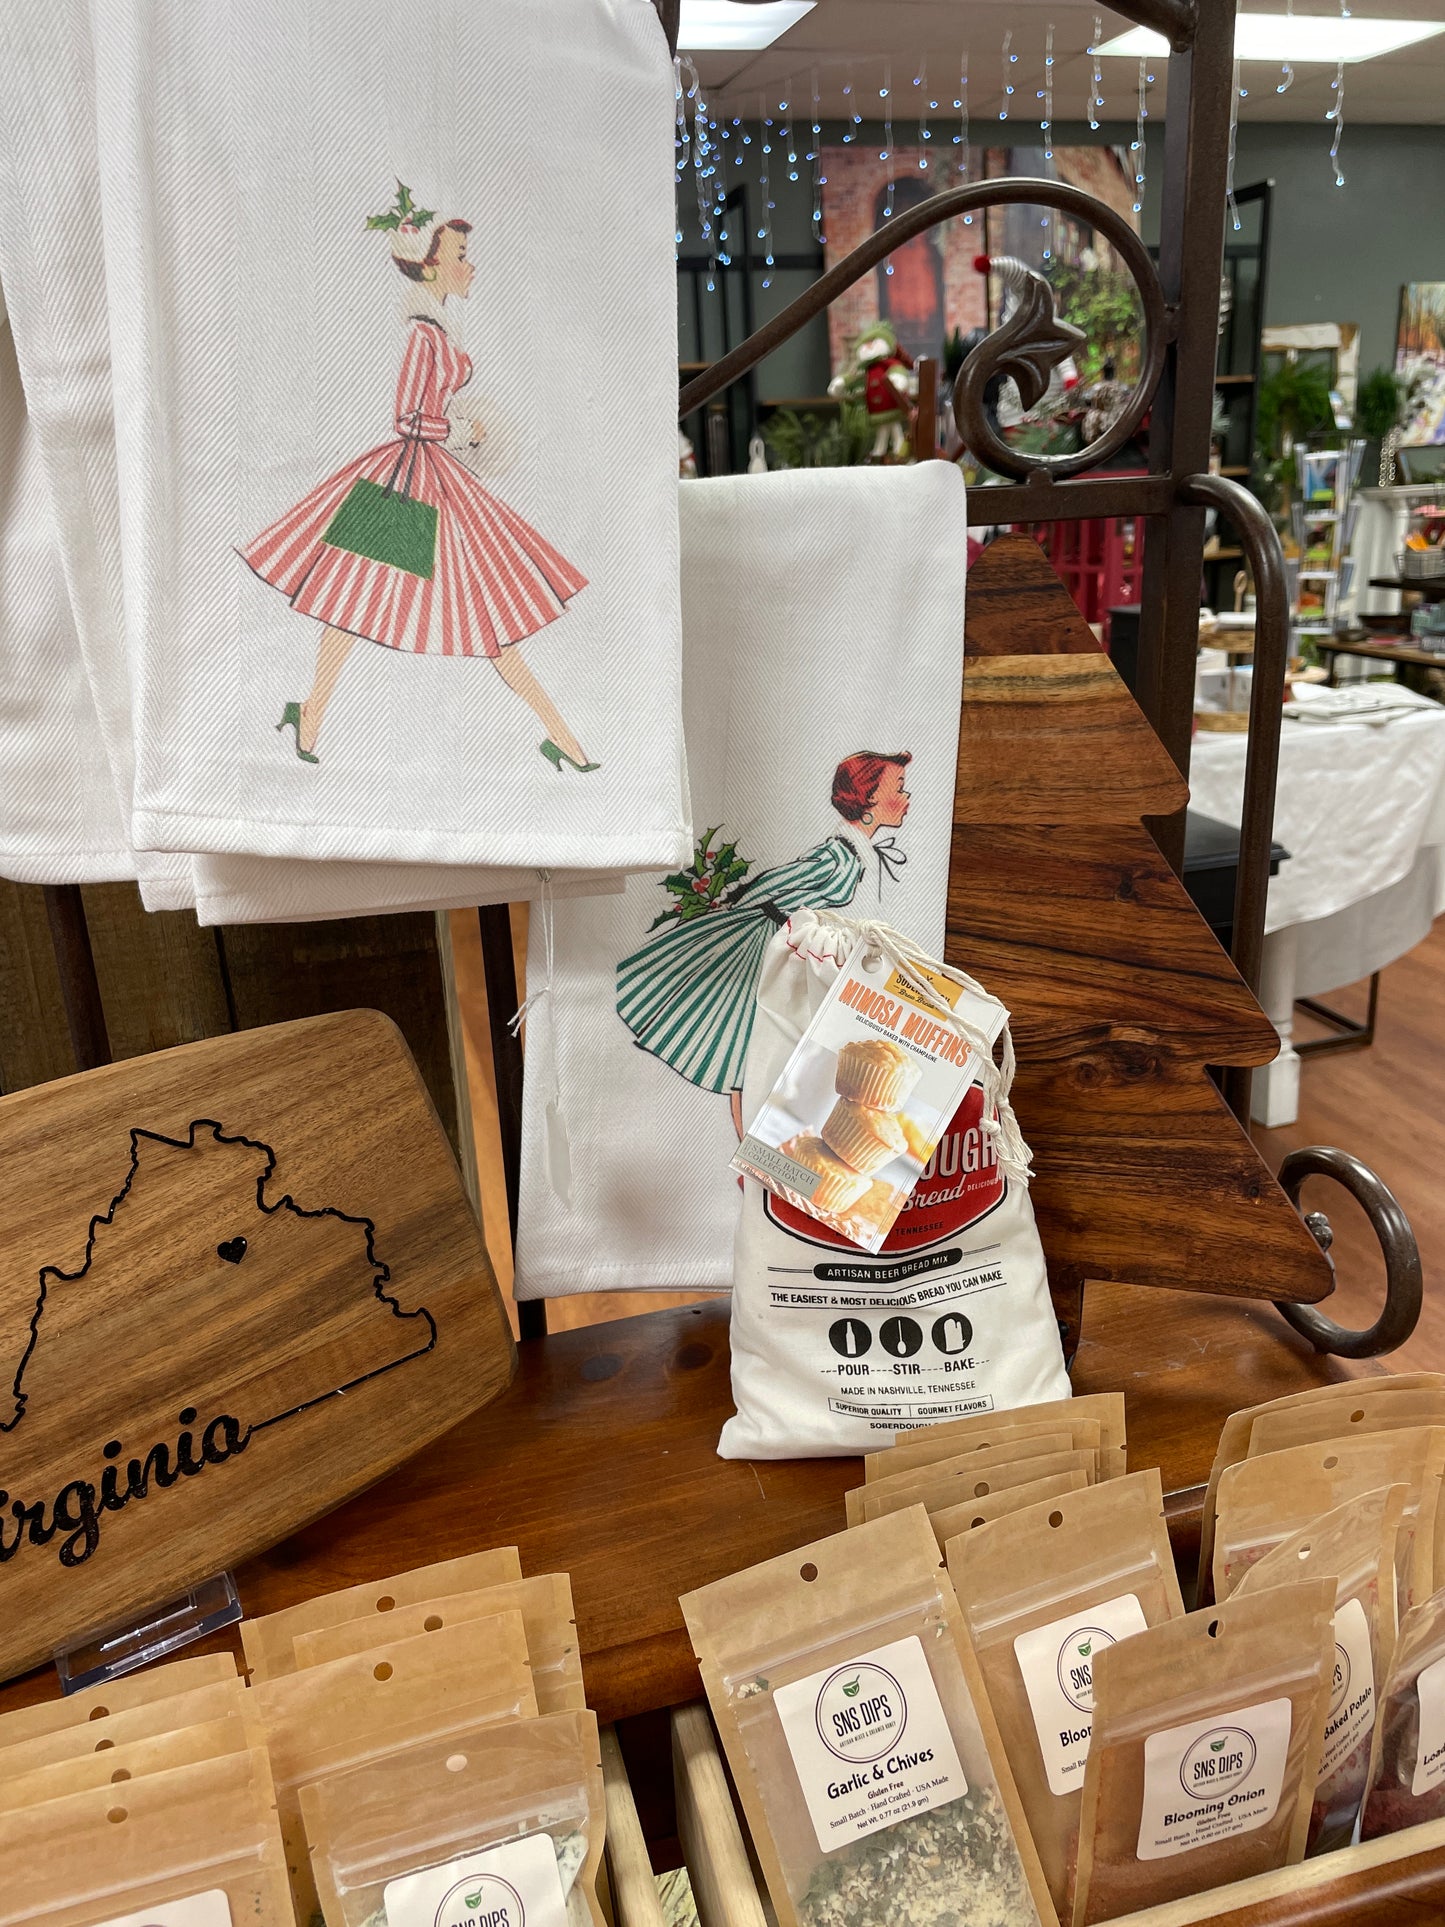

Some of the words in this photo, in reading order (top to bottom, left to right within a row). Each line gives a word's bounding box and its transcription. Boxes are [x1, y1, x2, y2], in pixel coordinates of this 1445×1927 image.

[839, 978, 903, 1031] MIMOSA
[900, 1012, 972, 1068] MUFFINS
[855, 1015, 884, 1033] DELICIOUSLY
[883, 1029, 898, 1042] BAKED
[898, 1038, 910, 1048] WITH
[909, 1044, 938, 1063] CHAMPAGNE
[748, 1151, 798, 1184] COLLECTION
[751, 1144, 781, 1166] SMALL
[783, 1160, 814, 1185] BATCH
[896, 1220, 944, 1236] TENNESSEE
[826, 1268, 872, 1279] ARTISAN
[874, 1268, 900, 1279] BEER
[902, 1260, 930, 1275] BREAD
[932, 1254, 949, 1266] MIX
[771, 1292, 789, 1303] THE
[790, 1293, 828, 1305] EASIEST
[830, 1295, 838, 1305] &
[840, 1296, 866, 1306] MOST
[869, 1293, 916, 1306] DELICIOUS
[918, 1286, 946, 1302] BREAD
[944, 1280, 962, 1294] YOU
[963, 1276, 980, 1289] CAN
[980, 1270, 1003, 1286] MAKE
[838, 1364, 870, 1376] POUR
[892, 1364, 921, 1376] STIR
[944, 1358, 976, 1373] BAKE
[841, 1386, 865, 1396] MADE
[868, 1386, 876, 1395] IN
[878, 1386, 926, 1396] NASHVILLE,
[928, 1380, 976, 1394] TENNESSEE
[835, 1402, 870, 1416] SUPERIOR
[870, 1408, 902, 1416] QUALITY
[918, 1406, 953, 1416] GOURMET
[954, 1400, 987, 1412] FLAVORS
[1070, 1664, 1092, 1690] SNS
[833, 1706, 860, 1737] SNS
[860, 1694, 892, 1726] DIPS
[1349, 1687, 1372, 1716] Potato
[827, 1773, 870, 1800] Garlic
[872, 1764, 884, 1780] &
[886, 1748, 934, 1774] Chives
[1062, 1762, 1077, 1774] Small
[1194, 1758, 1216, 1780] SNS
[1218, 1752, 1244, 1774] DIPS
[830, 1816, 848, 1828] Small
[848, 1808, 866, 1822] Batch
[870, 1800, 888, 1812] Hand
[888, 1790, 912, 1804] Crafted
[916, 1782, 931, 1793] USA
[932, 1776, 949, 1787] Made
[868, 1787, 889, 1800] Gluten
[889, 1781, 904, 1792] Free
[857, 1820, 868, 1830] Net
[869, 1816, 879, 1826] Wt.
[880, 1810, 892, 1820] 0.77
[916, 1796, 930, 1808] gm)
[1164, 1802, 1224, 1826] Blooming
[1228, 1788, 1266, 1806] Onion
